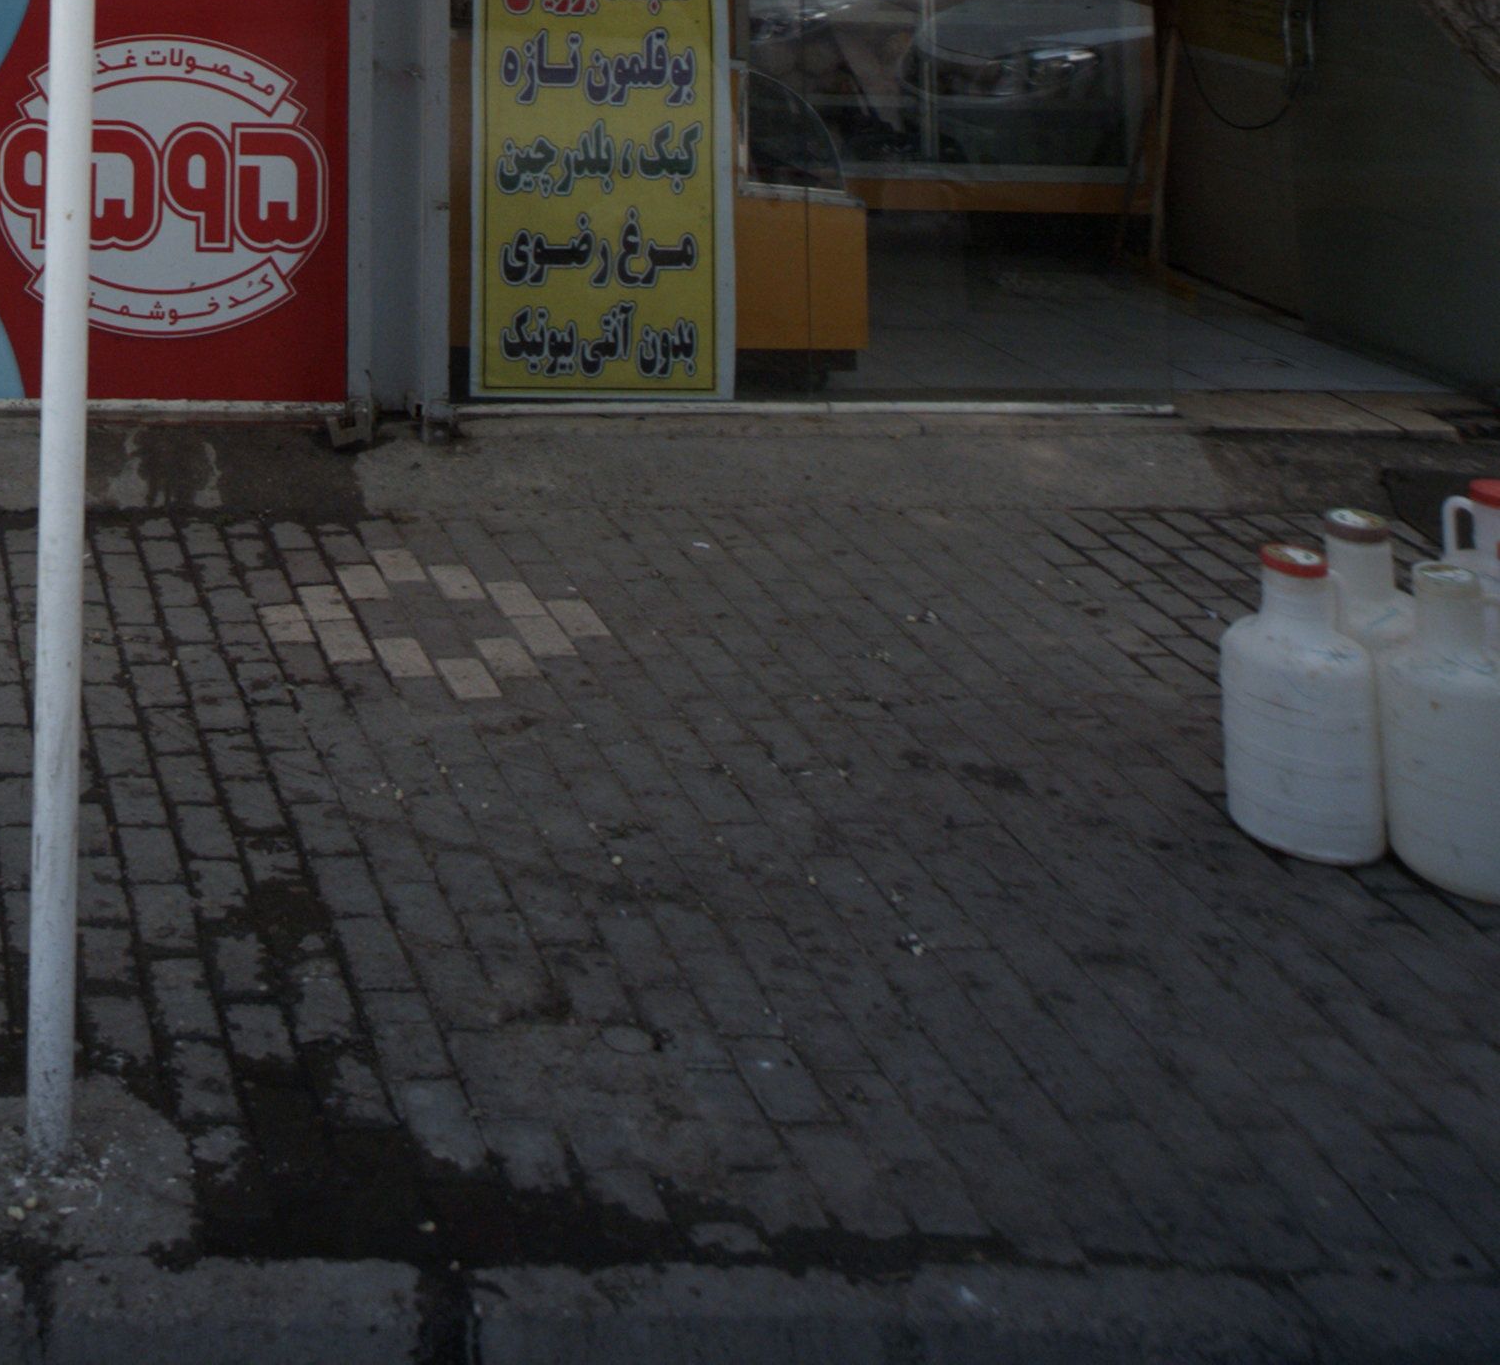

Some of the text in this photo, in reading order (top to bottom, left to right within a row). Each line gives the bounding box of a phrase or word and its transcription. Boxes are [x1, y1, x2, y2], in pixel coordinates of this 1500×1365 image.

[145, 48, 275, 97] محصولات
[503, 31, 695, 103] بوقلمون تازه
[498, 122, 614, 196] بلدرچین
[502, 208, 696, 287] مرغ رضوی
[502, 302, 696, 378] بدون آنتی بیوتیک
